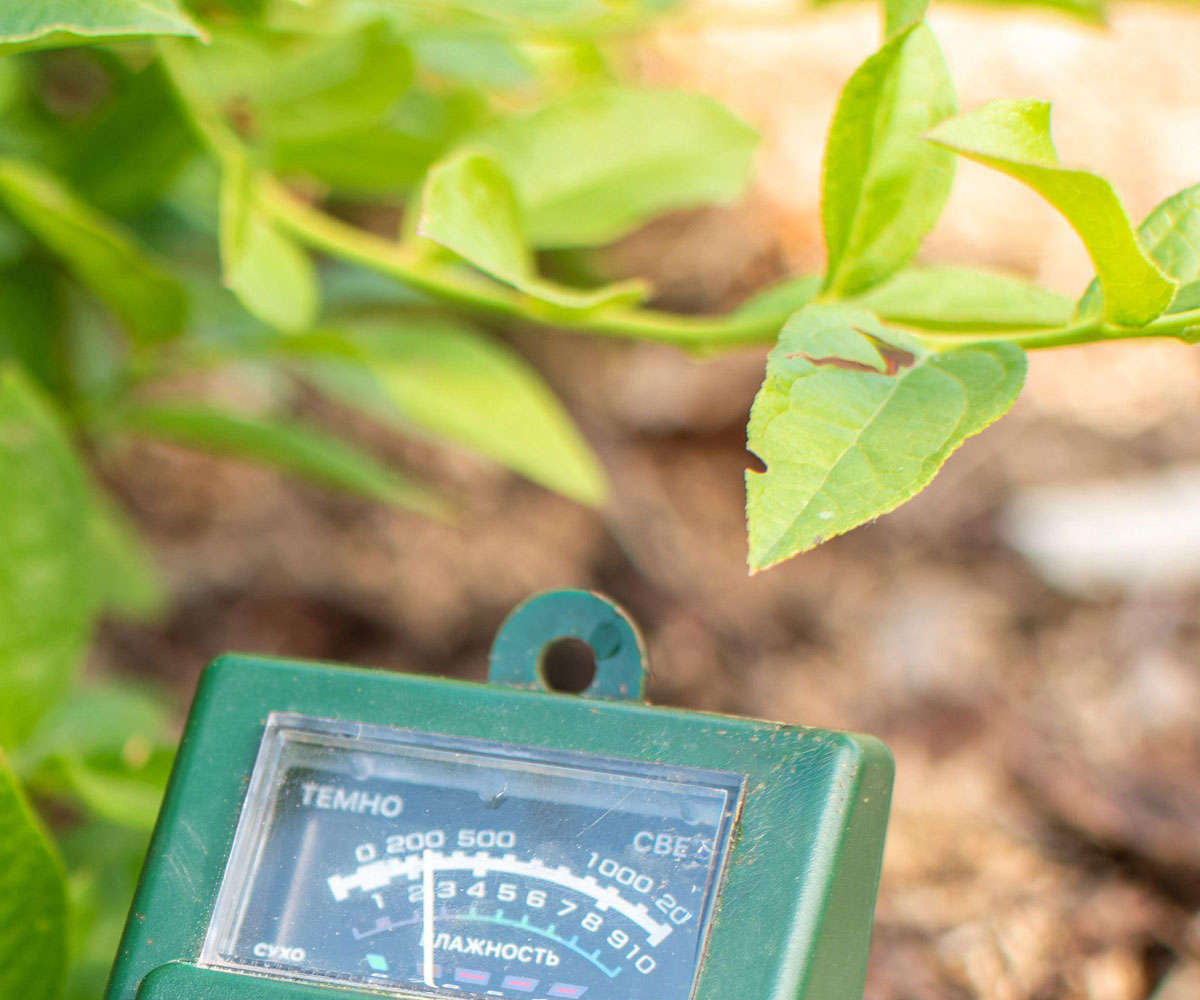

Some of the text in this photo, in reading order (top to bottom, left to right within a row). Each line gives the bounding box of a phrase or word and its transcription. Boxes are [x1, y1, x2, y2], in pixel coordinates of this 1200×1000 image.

[301, 782, 404, 818] ТЕМНО
[355, 842, 376, 863] 0
[385, 829, 445, 855] 200
[457, 828, 516, 849] 500
[587, 851, 654, 894] 1000
[371, 892, 385, 910] 1
[436, 880, 458, 900] 3
[466, 880, 487, 899] 4
[497, 883, 517, 902] 5
[526, 889, 547, 908] 6
[556, 899, 578, 917] 7
[580, 912, 604, 932] 8
[606, 929, 630, 950] 9
[625, 943, 657, 975] 10
